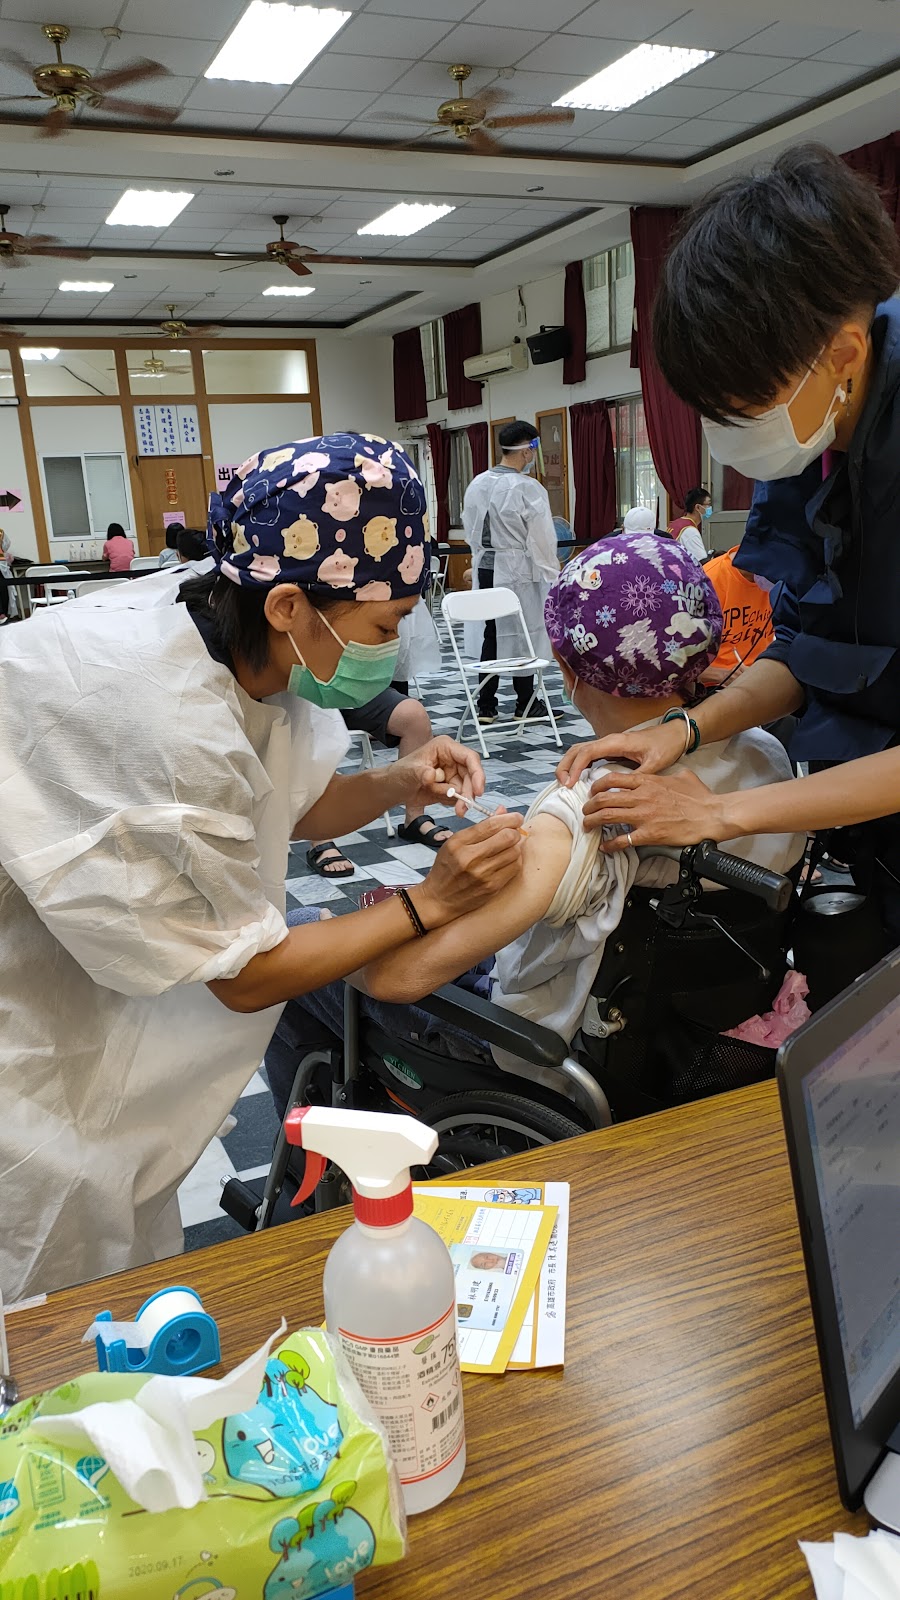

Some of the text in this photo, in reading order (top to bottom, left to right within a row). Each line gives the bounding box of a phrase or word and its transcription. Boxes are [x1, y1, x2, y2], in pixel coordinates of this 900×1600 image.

[546, 1279, 556, 1309] 高雄市政府
